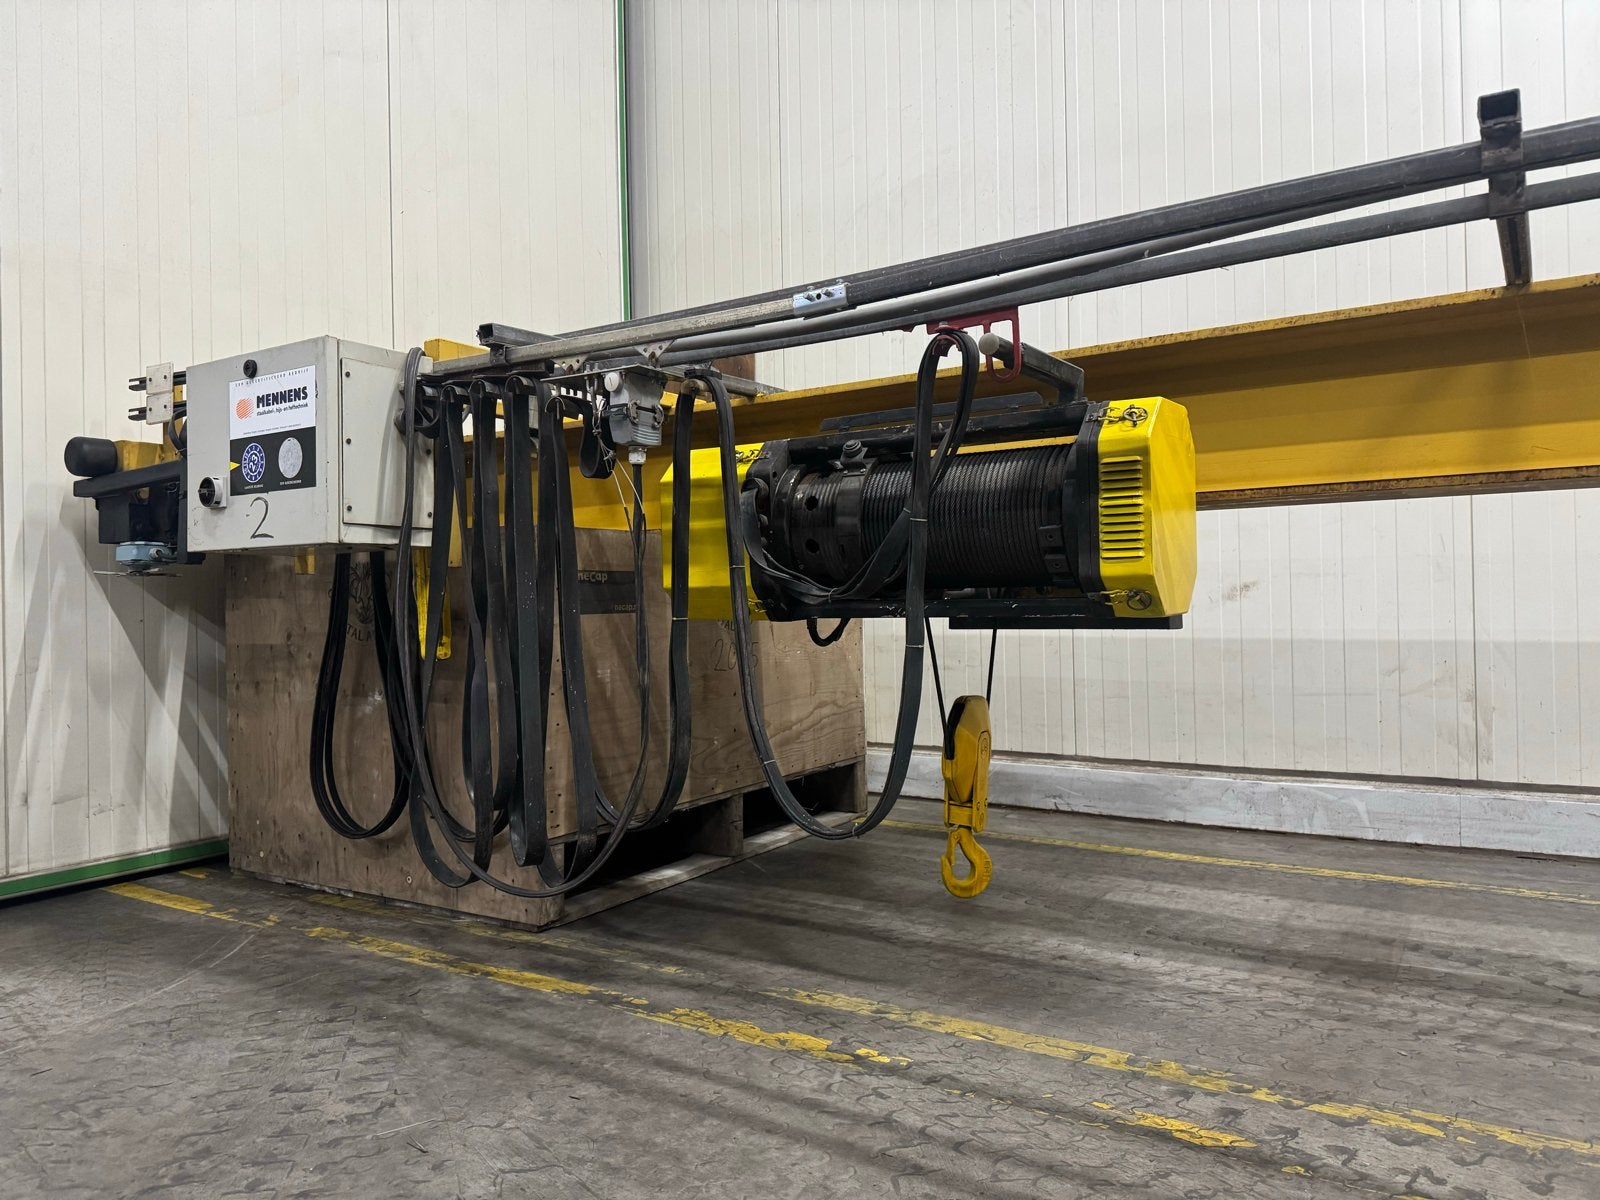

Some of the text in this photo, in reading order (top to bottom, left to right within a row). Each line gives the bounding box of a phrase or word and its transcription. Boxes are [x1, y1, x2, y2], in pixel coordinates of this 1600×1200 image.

[256, 386, 308, 409] MENNENS
[249, 454, 258, 472] 23
[250, 496, 274, 539] 2
[714, 639, 759, 671] 205
